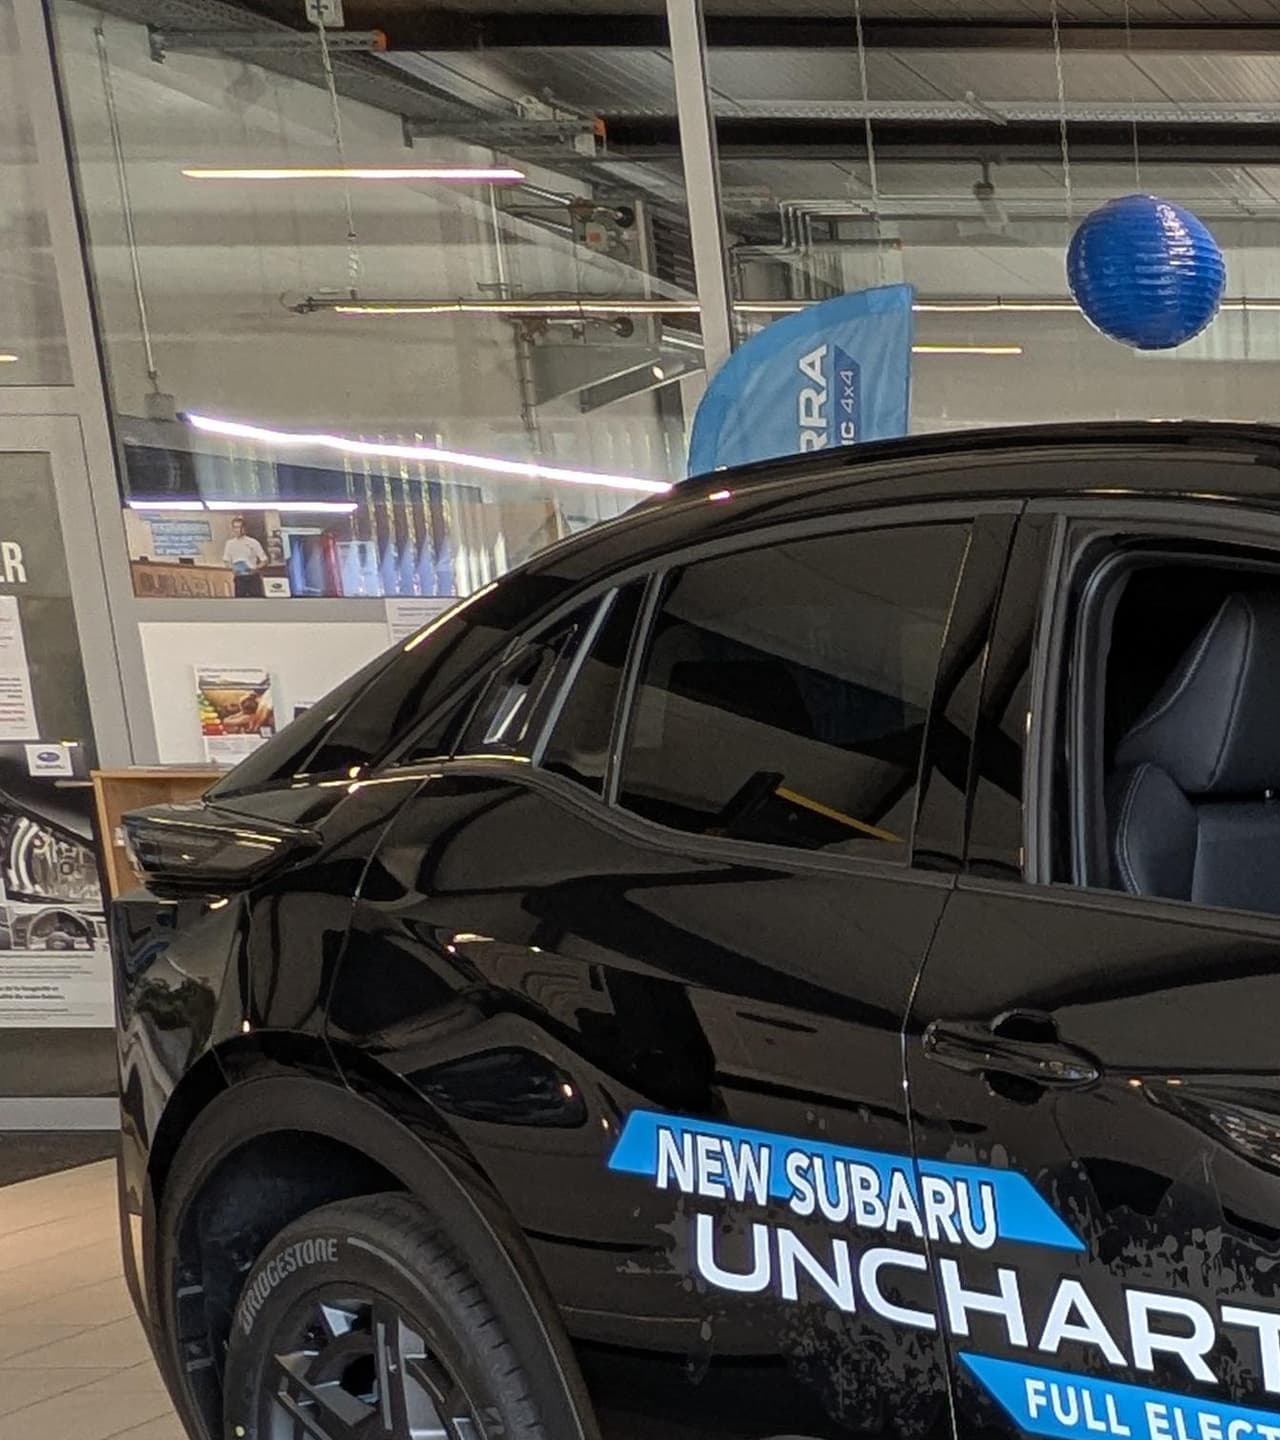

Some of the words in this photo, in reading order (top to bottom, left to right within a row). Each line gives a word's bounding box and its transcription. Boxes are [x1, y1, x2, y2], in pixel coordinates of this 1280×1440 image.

[840, 370, 855, 414] 4x4
[0, 541, 28, 584] R
[654, 1126, 773, 1208] NEW
[784, 1149, 1001, 1250] SUBARU
[238, 1237, 340, 1336] BRIDGESTONE
[1023, 1379, 1132, 1438] FULL
